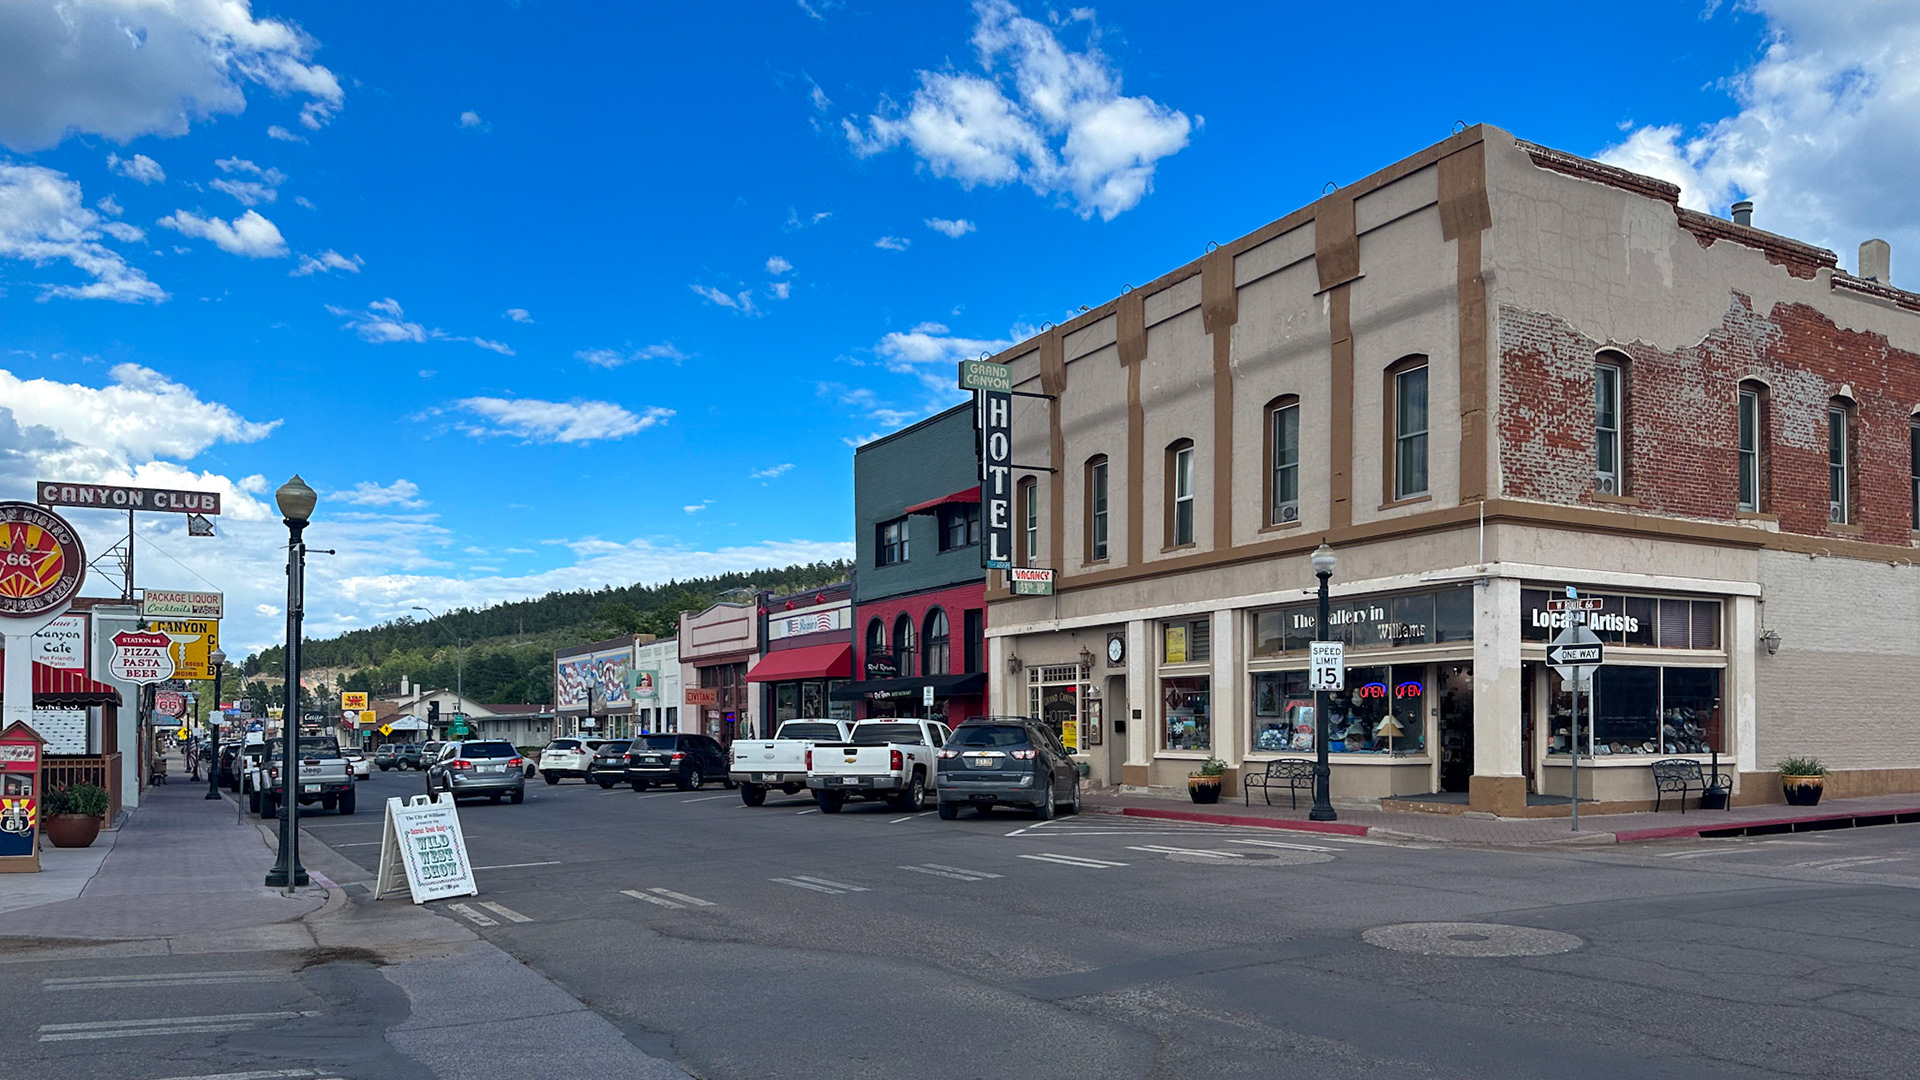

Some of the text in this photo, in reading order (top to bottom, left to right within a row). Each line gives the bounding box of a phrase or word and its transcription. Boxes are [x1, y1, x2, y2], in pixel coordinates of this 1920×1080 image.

[969, 363, 1008, 378] GRAND
[966, 374, 1010, 389] CANYON
[989, 398, 1009, 562] HOTEL
[43, 485, 216, 510] CANYON CLUB
[6, 553, 31, 567] 66
[1015, 570, 1050, 581] VACANCY
[44, 575, 75, 603] PIZZA
[147, 592, 219, 605] PACKAGE LIQUOR
[1564, 601, 1583, 610] ROUTE
[1584, 600, 1594, 609] 66
[147, 603, 191, 614] Cocktails
[1292, 605, 1384, 629] The allery in
[1590, 612, 1639, 633] Artists
[157, 621, 208, 634] CANYON
[1377, 621, 1426, 640] Williams
[43, 641, 72, 653] Cafe
[123, 648, 160, 657] PIZZA
[1313, 647, 1342, 656] SPEED
[1316, 657, 1338, 665] LIMIT
[1562, 649, 1597, 660] ONE WAY
[123, 658, 160, 667] PASTA
[126, 669, 158, 678] BEER
[1317, 667, 1337, 685] 15
[687, 692, 710, 702] CIVITAN
[1360, 685, 1386, 698] OPEN
[1395, 684, 1421, 697] OPEN
[159, 701, 177, 710] 66
[415, 834, 450, 851] WILD
[418, 847, 454, 865] WEST
[422, 861, 457, 880] SHOW
